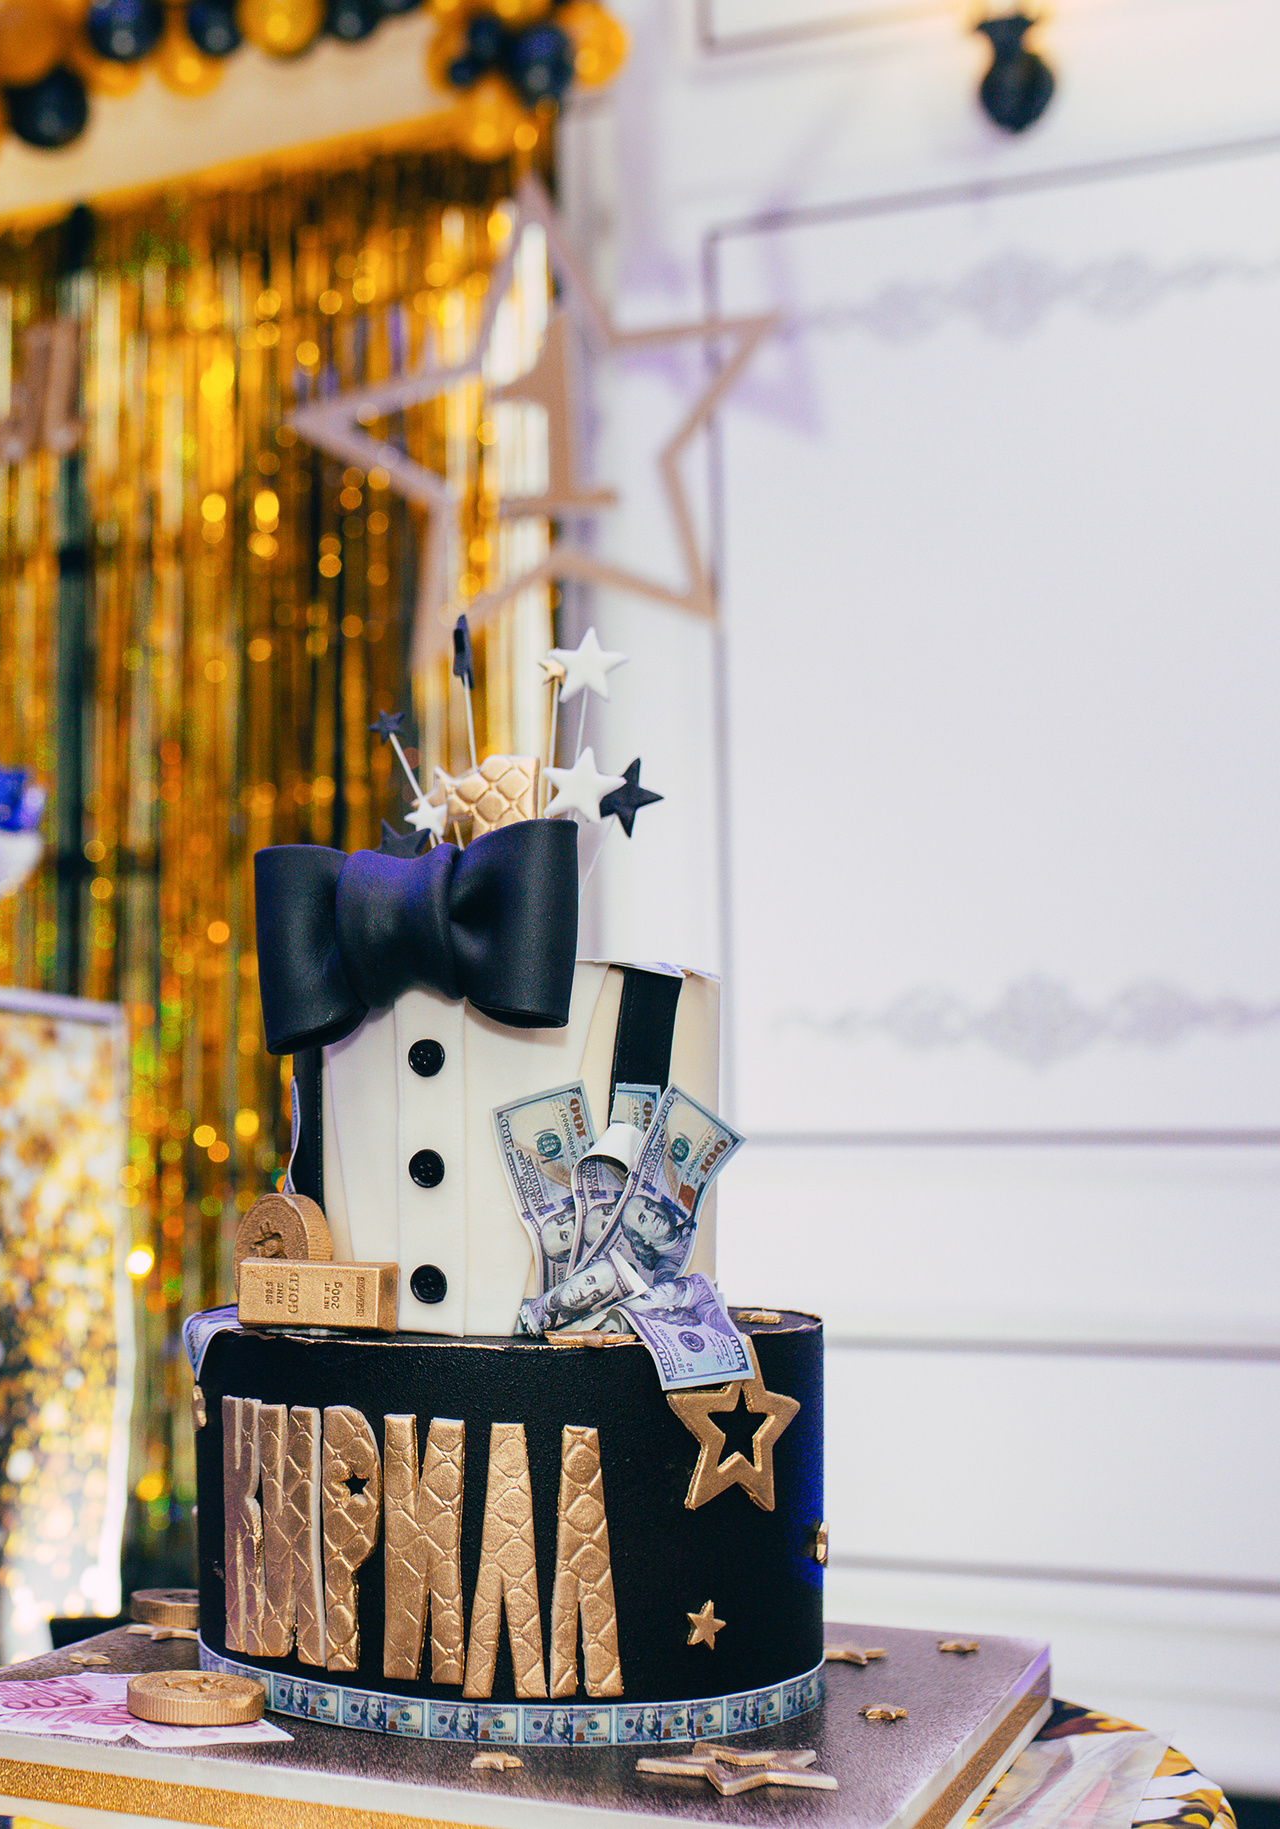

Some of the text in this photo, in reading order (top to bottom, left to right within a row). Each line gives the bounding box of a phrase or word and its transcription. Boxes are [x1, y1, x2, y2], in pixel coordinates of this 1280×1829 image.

[499, 1117, 514, 1149] 100
[568, 1097, 586, 1138] 100
[697, 1137, 729, 1174] 100
[287, 1272, 299, 1314] GOLD
[330, 1281, 343, 1309] 200g
[655, 1345, 674, 1379] 100
[728, 1334, 746, 1365] 100
[222, 1395, 624, 1698] КИРИЛЛ
